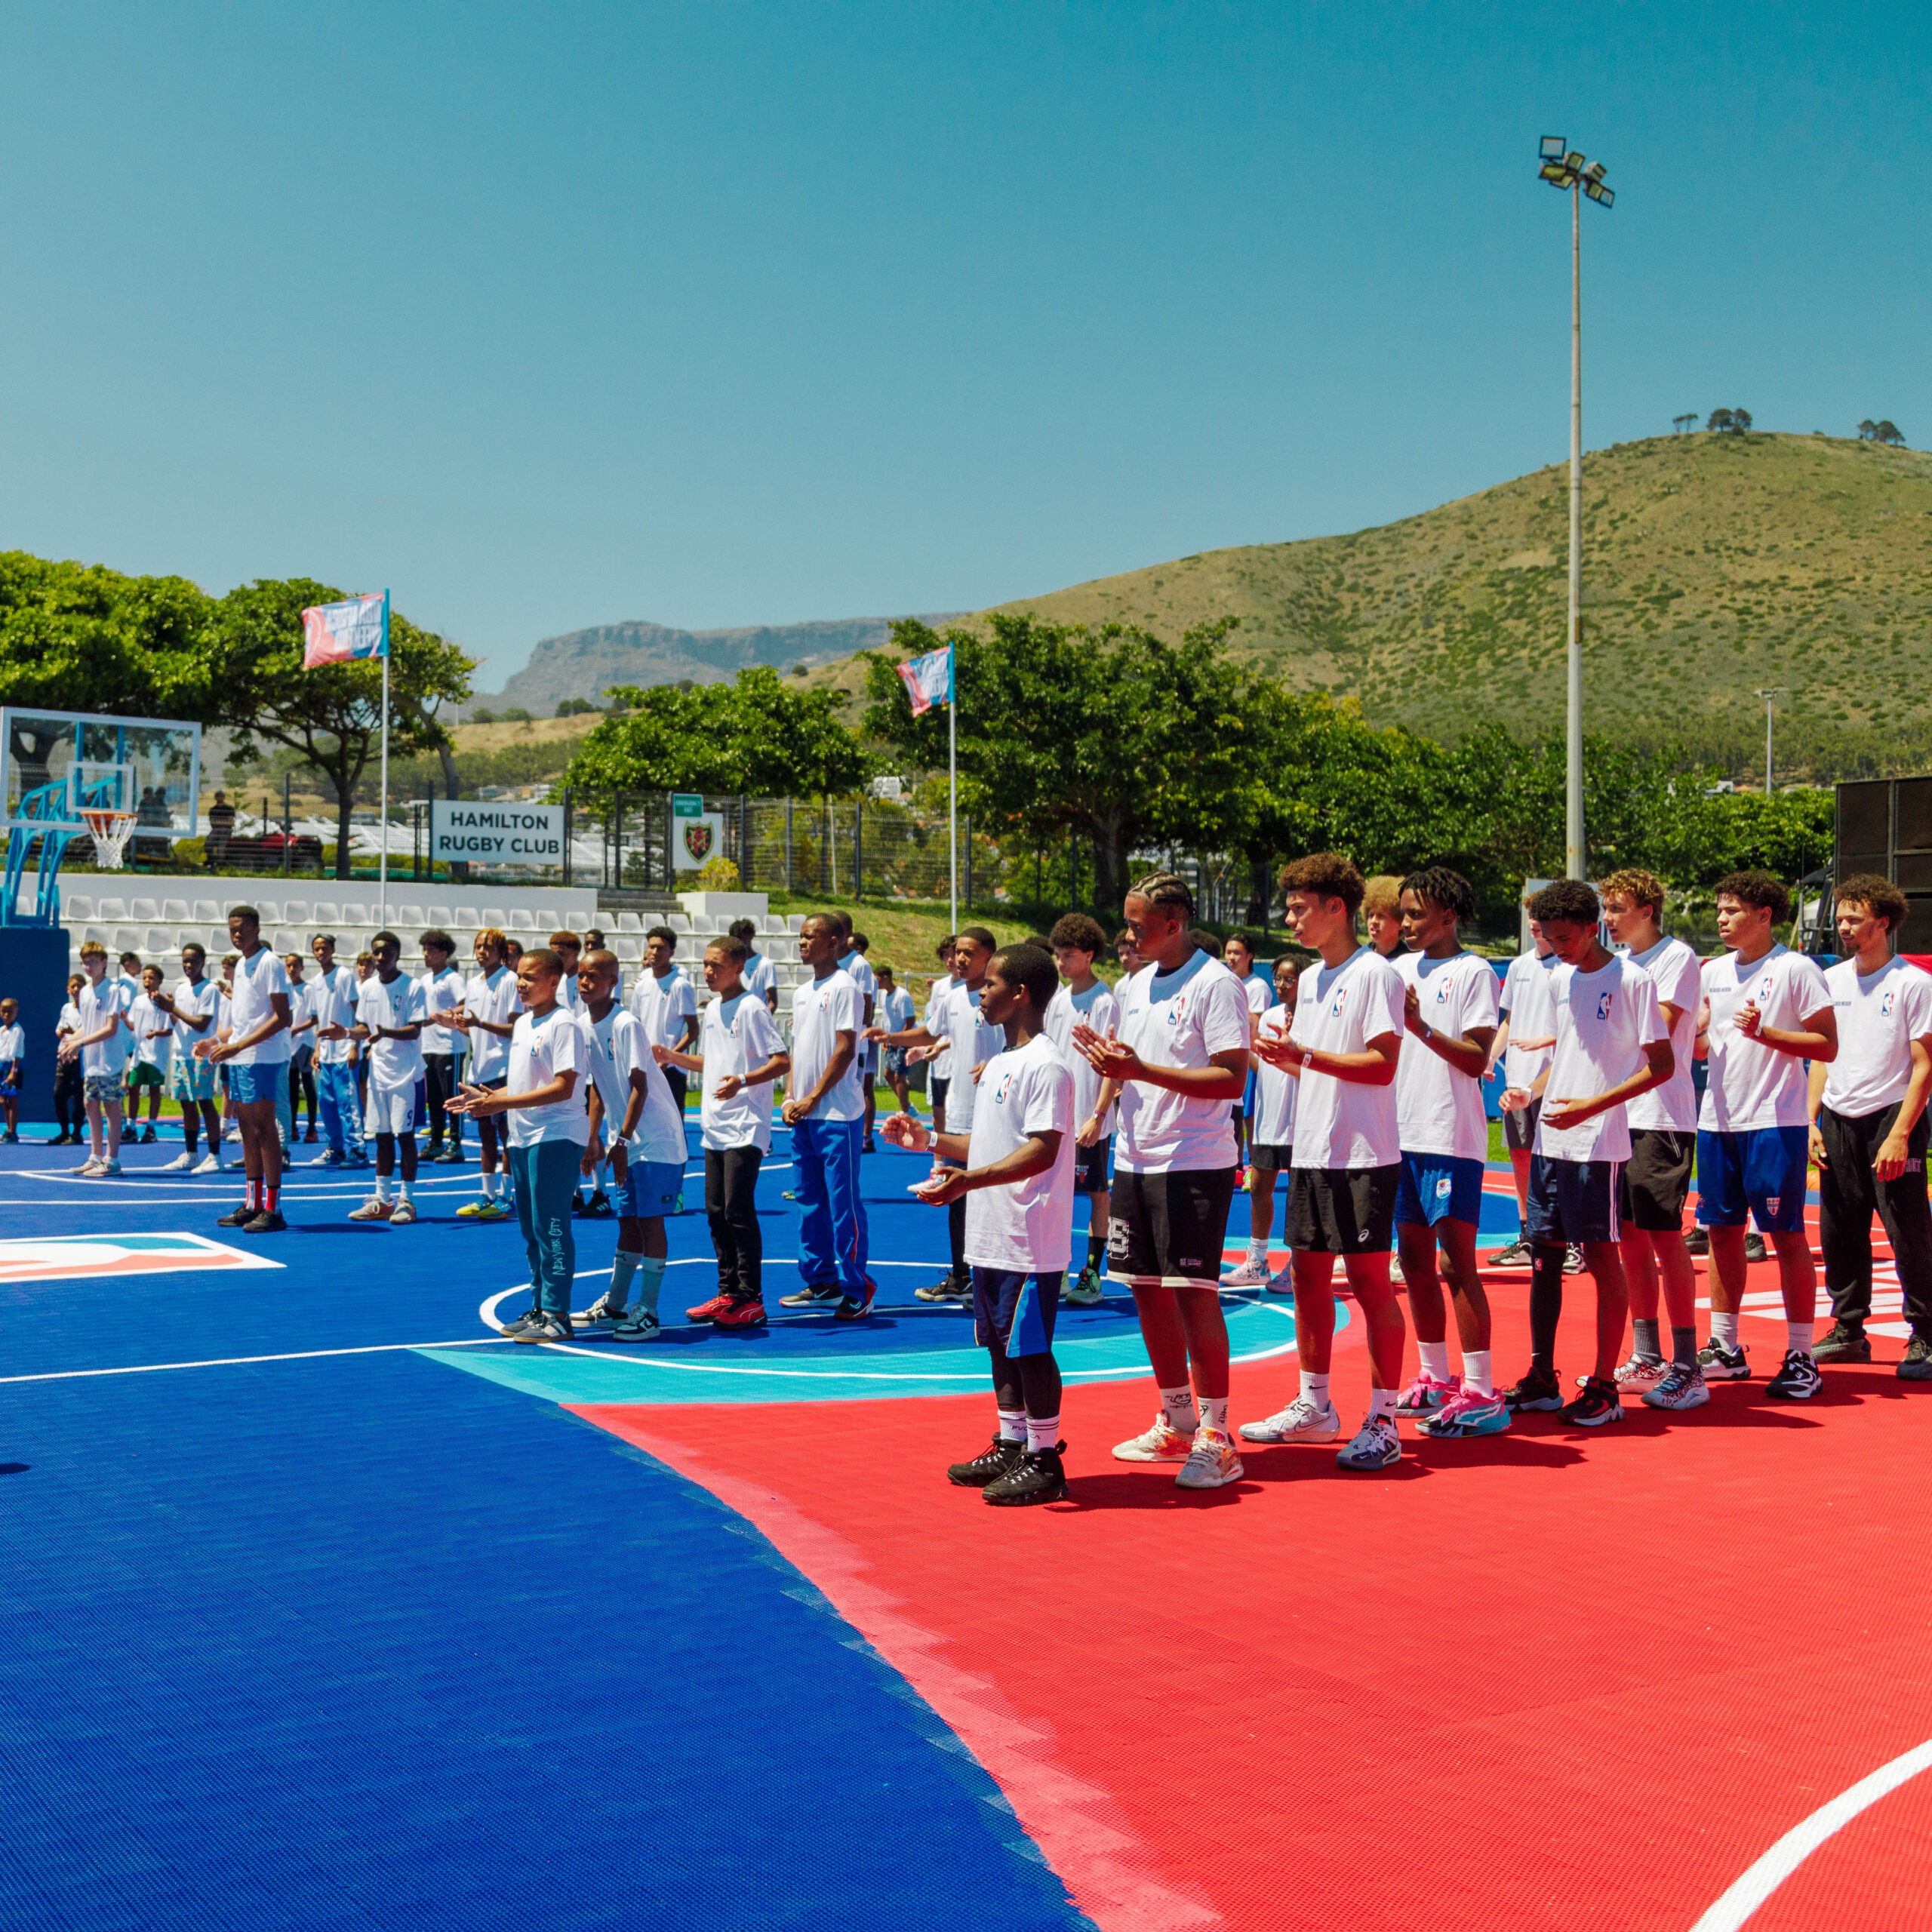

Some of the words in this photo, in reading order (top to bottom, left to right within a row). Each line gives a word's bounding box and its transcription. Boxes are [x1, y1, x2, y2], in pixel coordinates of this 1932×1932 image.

[451, 811, 549, 829] HAMILTON
[439, 835, 505, 852] RUGBY
[511, 838, 560, 854] CLUB
[407, 1109, 413, 1126] 9
[549, 1217, 563, 1236] CITY
[552, 1238, 565, 1257] YORK
[552, 1257, 566, 1275] NEW
